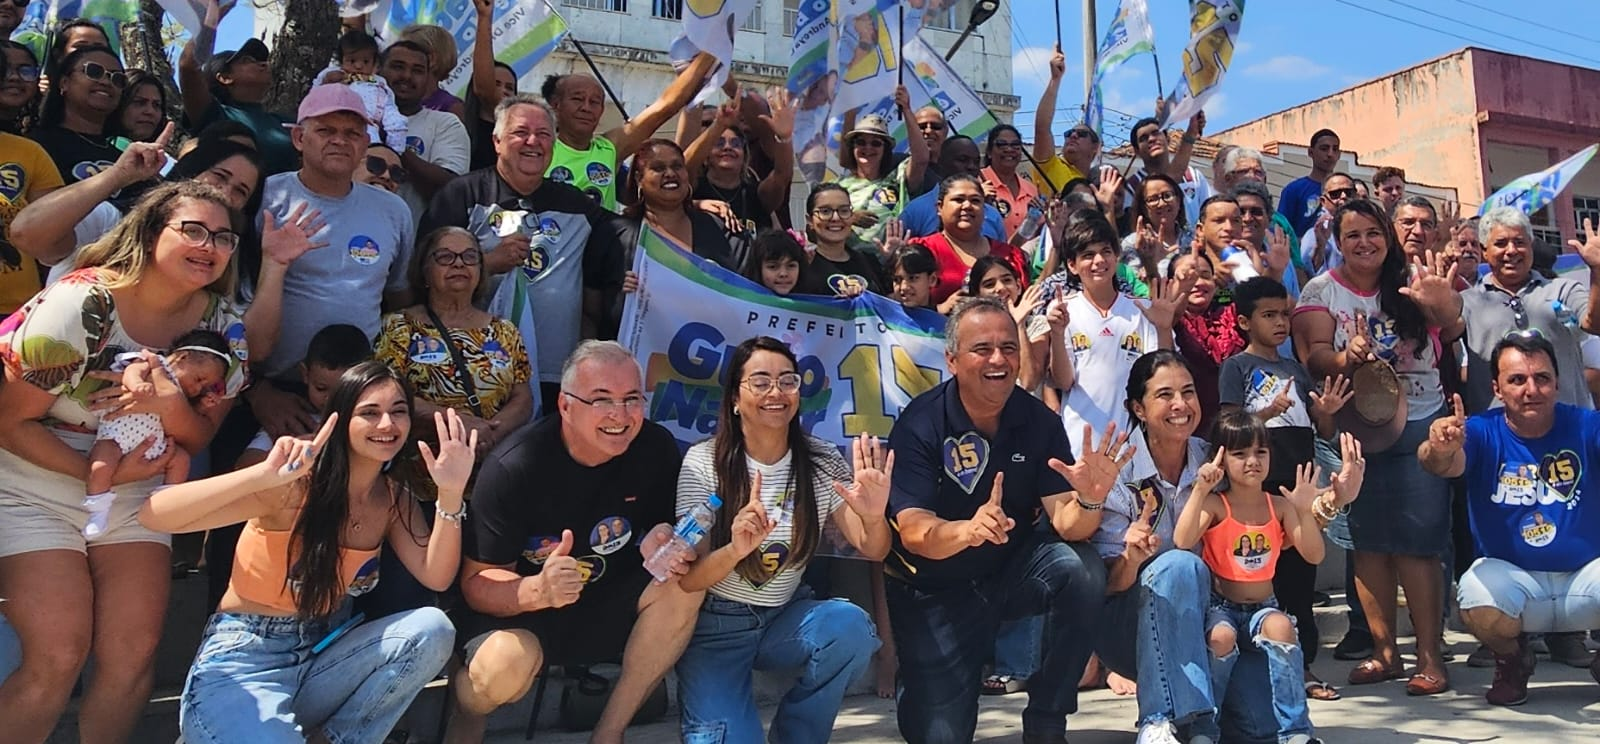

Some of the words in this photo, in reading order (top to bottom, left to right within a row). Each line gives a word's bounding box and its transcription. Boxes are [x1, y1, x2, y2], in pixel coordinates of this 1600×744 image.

[747, 311, 887, 339] PREFEITO
[951, 443, 980, 473] 15
[1548, 459, 1575, 484] 15
[762, 552, 781, 572] 5
